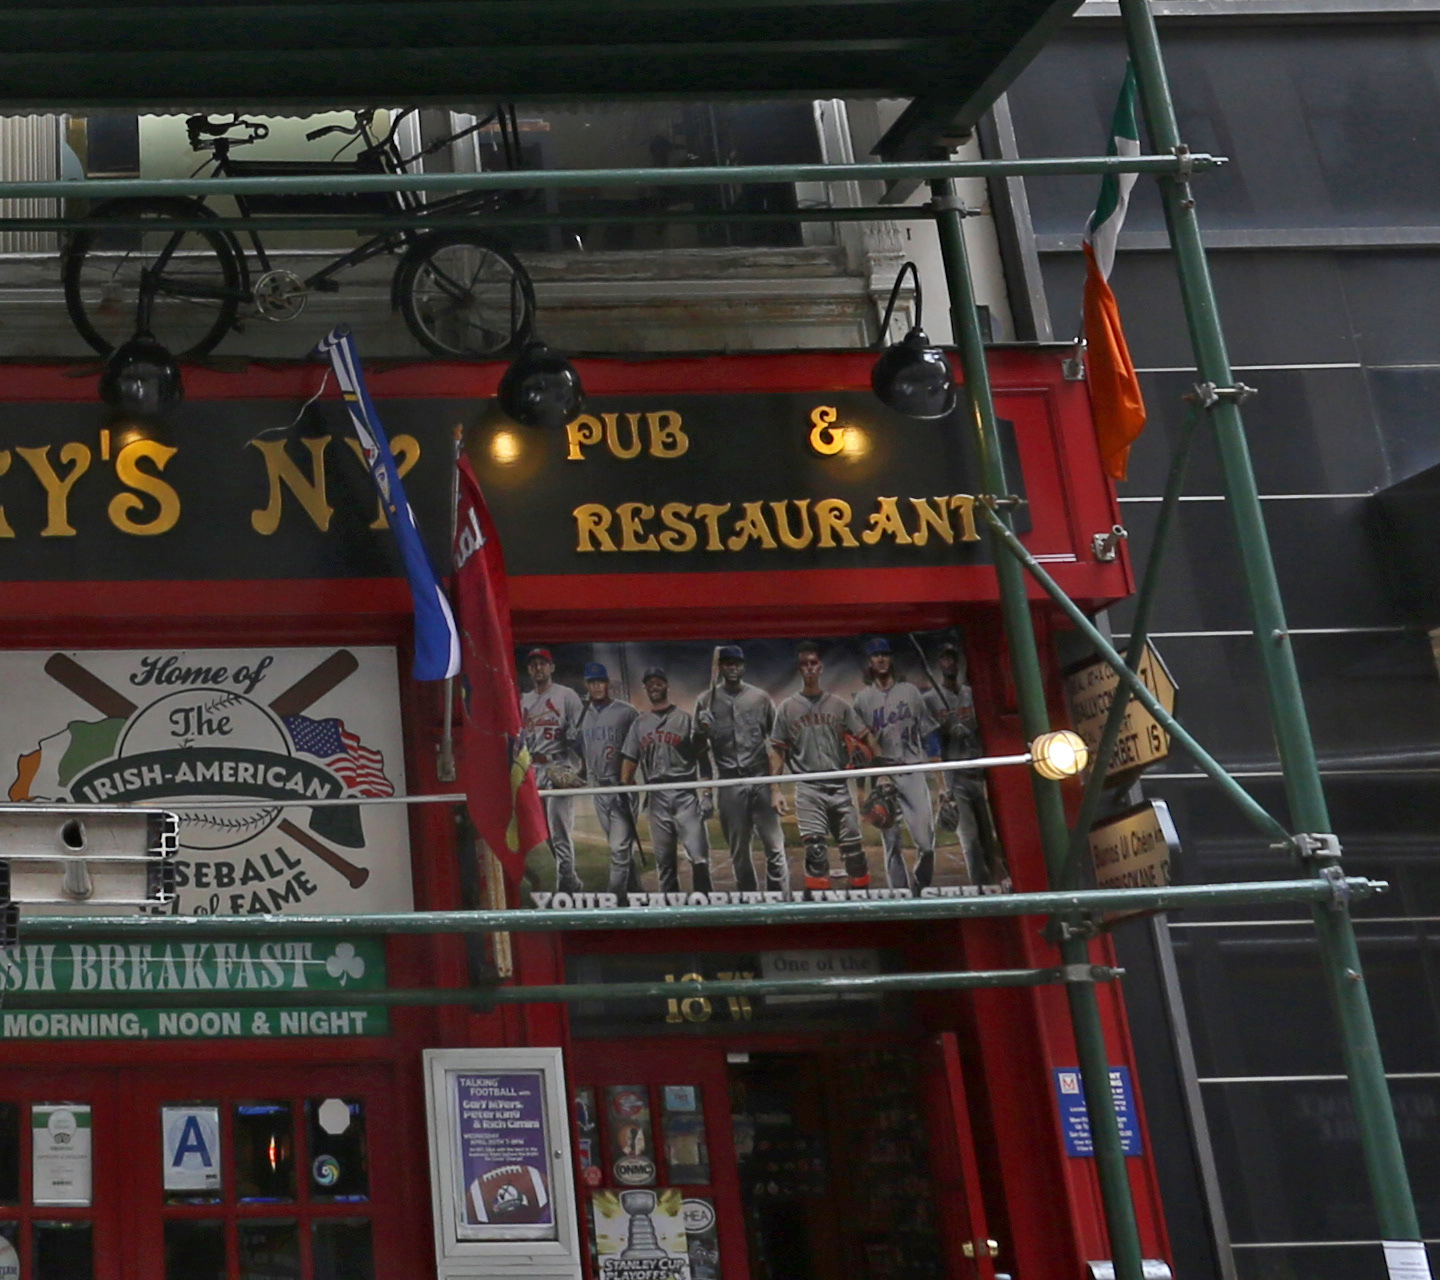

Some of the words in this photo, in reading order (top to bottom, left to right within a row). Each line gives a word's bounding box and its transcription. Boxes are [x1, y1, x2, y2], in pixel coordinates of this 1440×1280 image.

[567, 410, 689, 461] PUB
[809, 405, 847, 456] &
[571, 494, 983, 554] RESTAURANT
[128, 655, 228, 687] Home
[231, 654, 275, 693] of
[169, 706, 234, 738] The
[872, 700, 913, 731] Mets
[82, 759, 332, 804] IRISH-AMERICAN
[175, 845, 302, 889] SEBALL
[229, 870, 318, 915] FAME
[72, 942, 316, 992] BREAKFAST
[773, 955, 810, 973] One
[3, 1012, 150, 1039] MORNING,
[161, 1011, 242, 1036] NOON
[251, 1011, 273, 1036] &
[278, 1010, 369, 1036] NIGHT
[470, 1087, 518, 1096] FOOTBALL
[171, 1115, 213, 1168] A
[604, 1258, 658, 1272] STANLEY
[659, 1257, 686, 1270] CUP
[606, 1269, 667, 1280] PLAYOFFS
